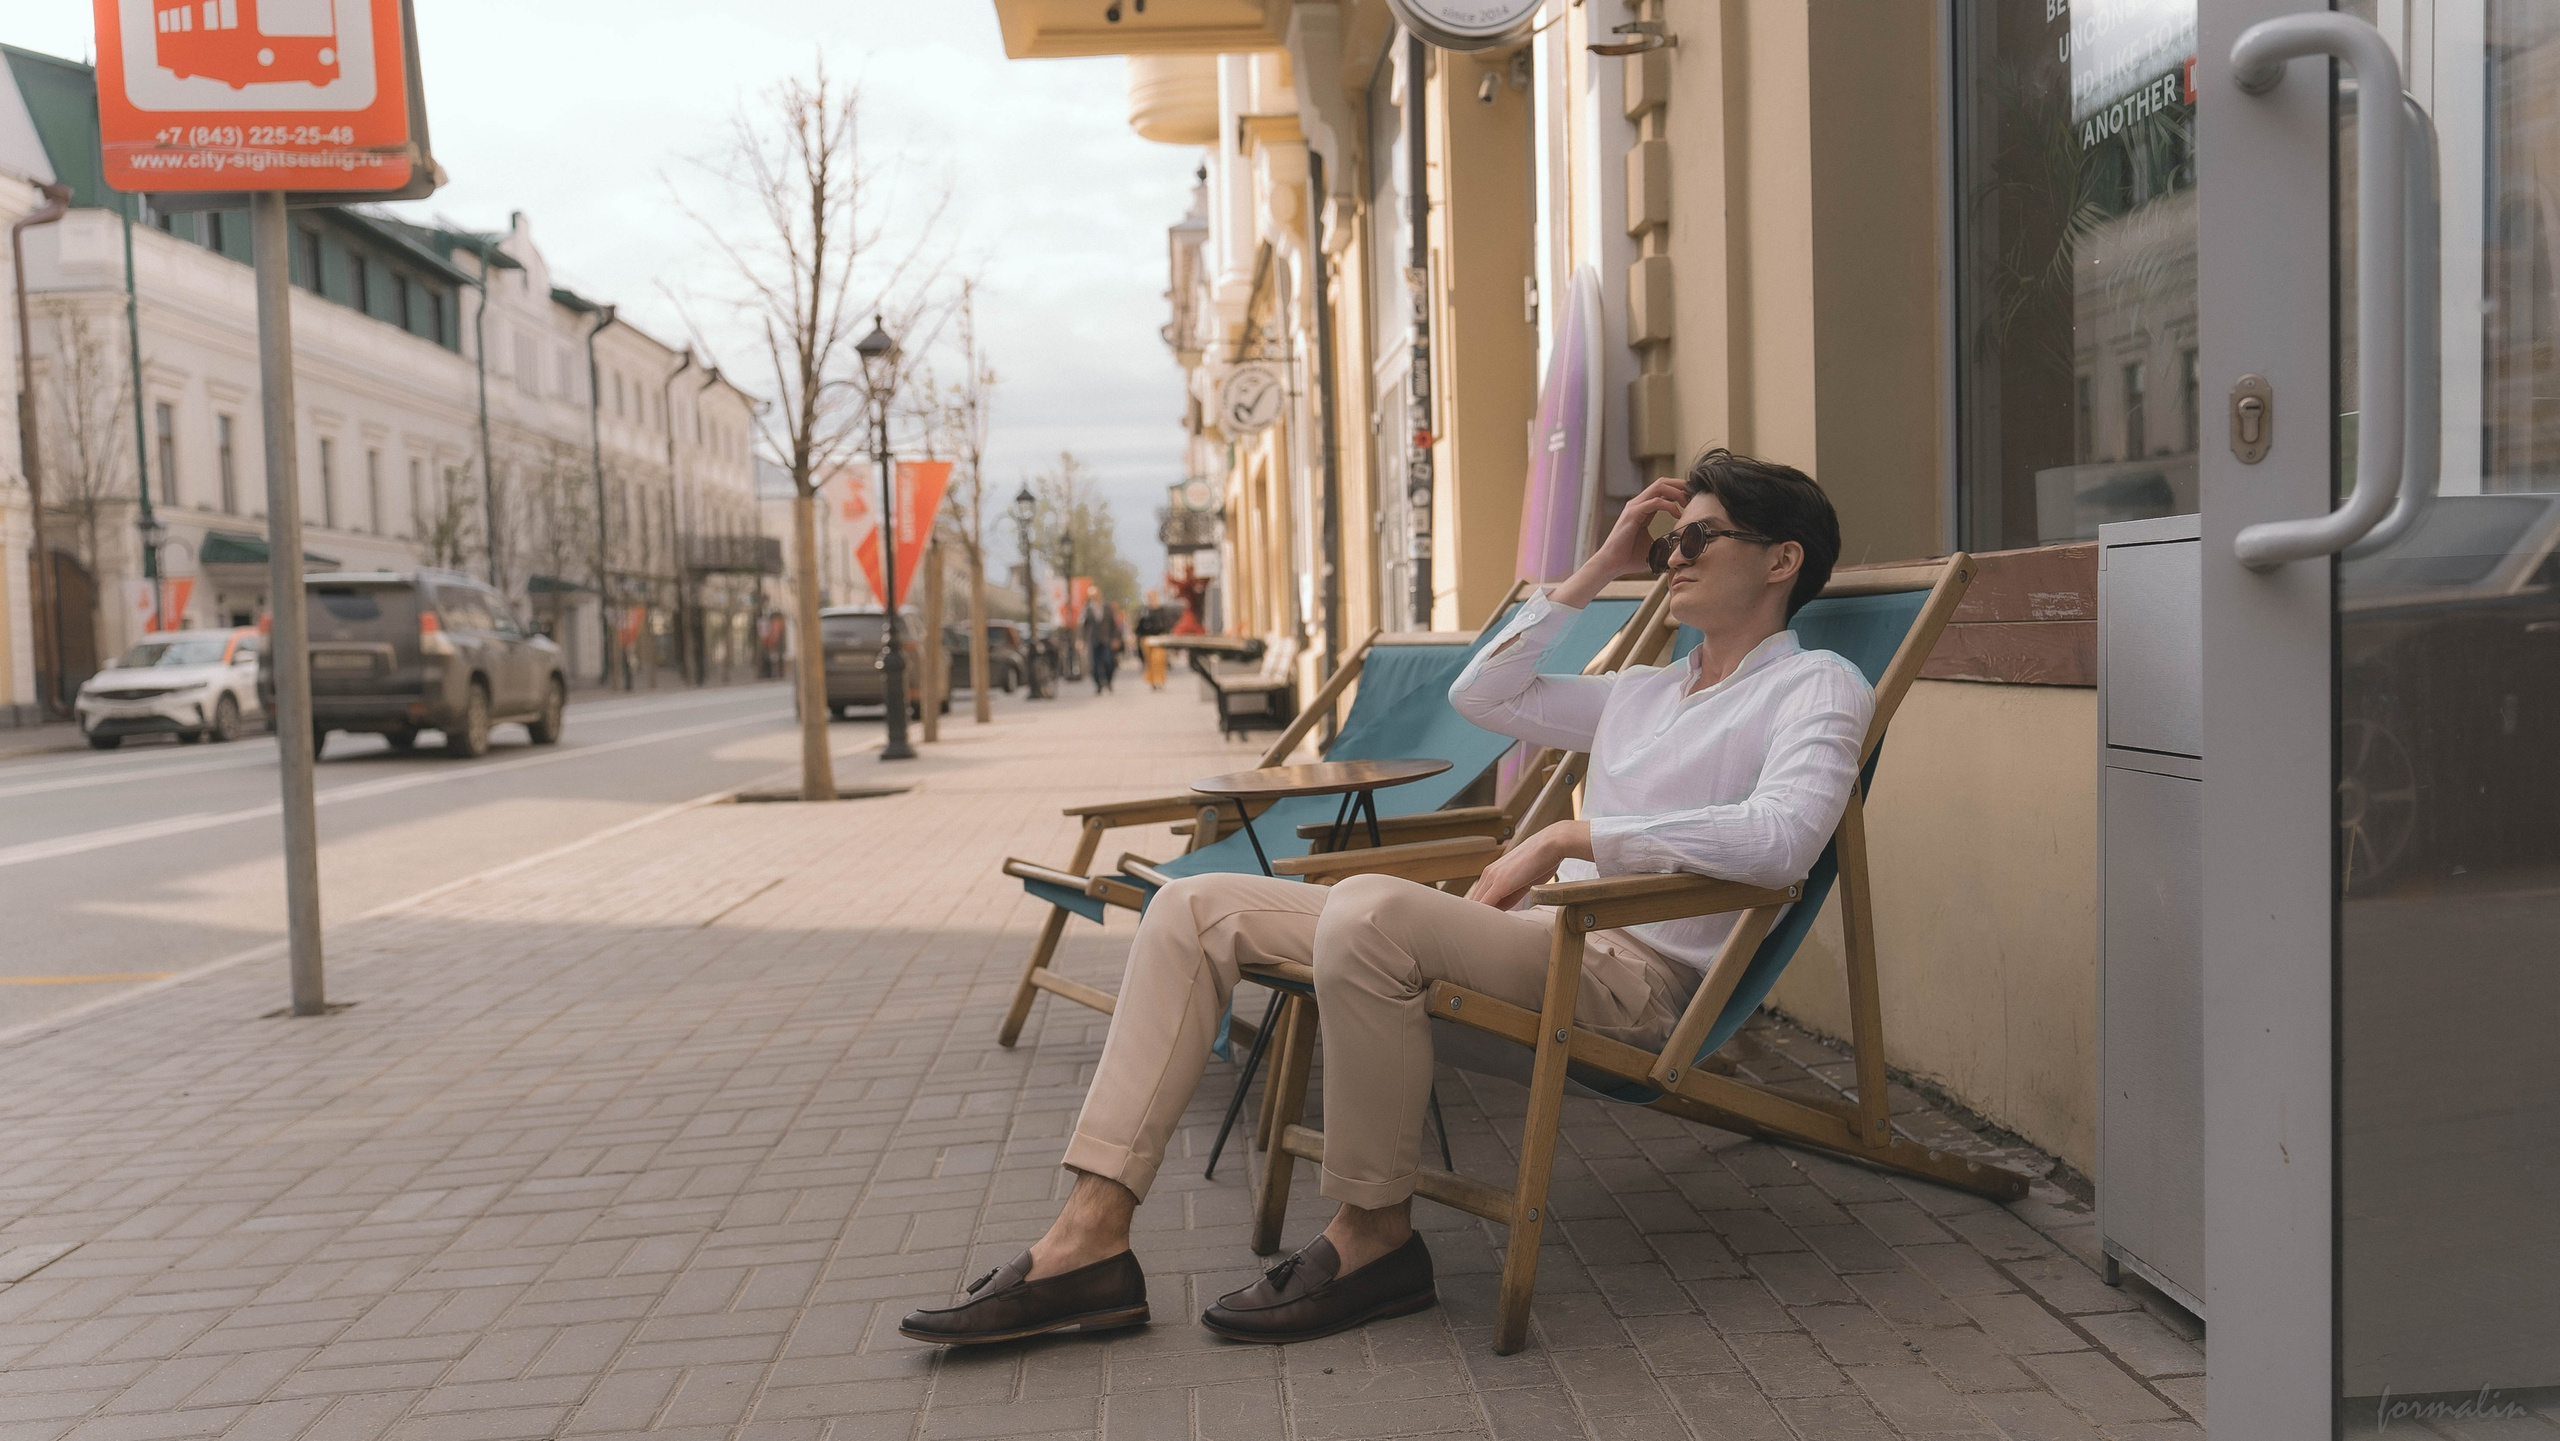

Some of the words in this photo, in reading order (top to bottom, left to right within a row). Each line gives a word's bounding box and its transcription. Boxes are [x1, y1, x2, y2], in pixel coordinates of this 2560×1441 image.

[1442, 6, 1475, 23] since
[1479, 3, 1510, 22] 2014
[2073, 69, 2095, 107] I'D
[2099, 39, 2140, 91] LIKE
[2145, 20, 2173, 60] TO
[2083, 74, 2177, 151] ANOTHER
[155, 127, 181, 145] +7
[189, 126, 244, 148] (843)
[249, 126, 355, 146] 225-25-48
[130, 151, 383, 172] www.city-sightseeing.ru
